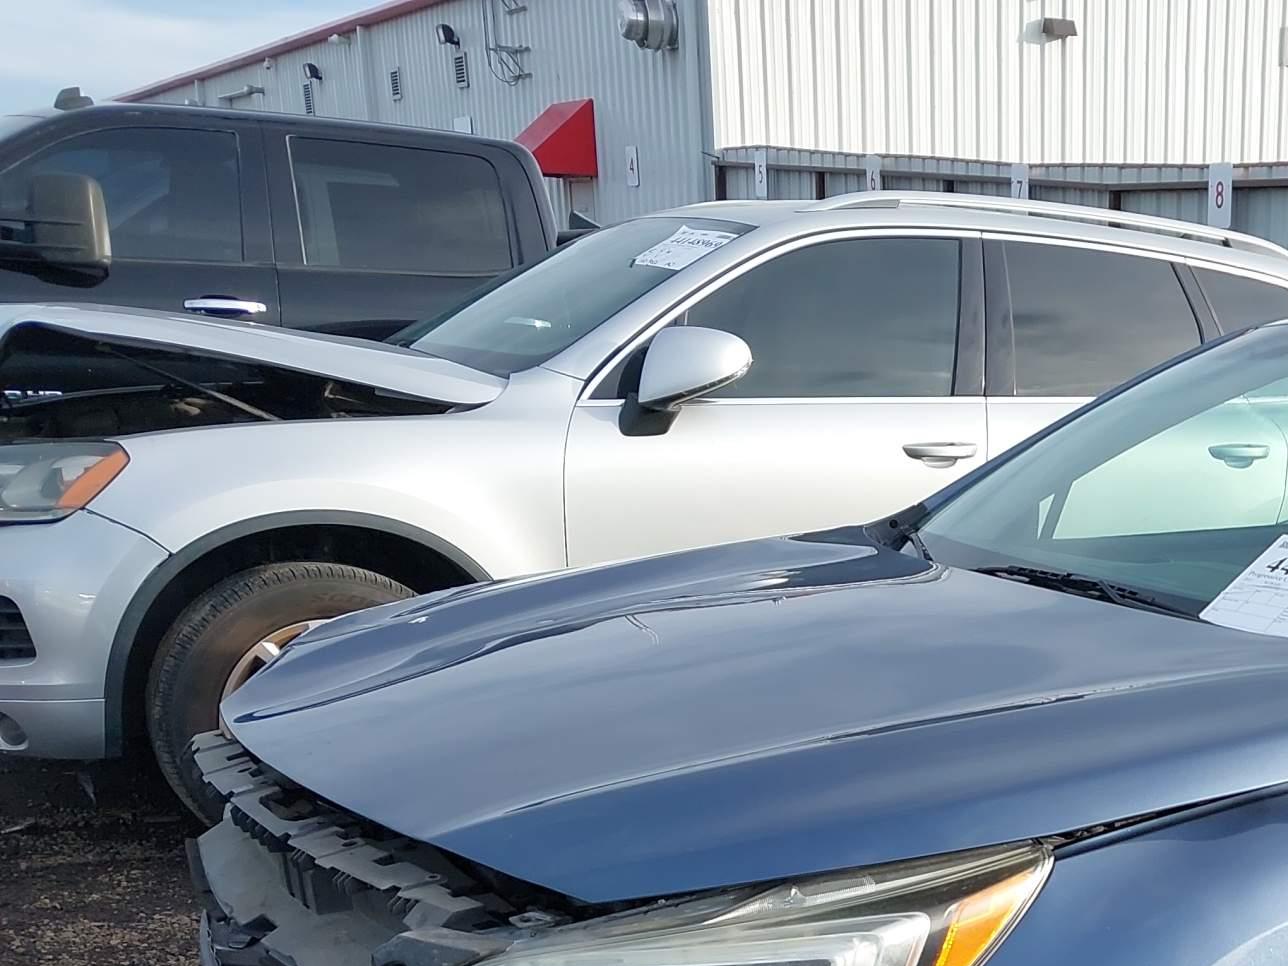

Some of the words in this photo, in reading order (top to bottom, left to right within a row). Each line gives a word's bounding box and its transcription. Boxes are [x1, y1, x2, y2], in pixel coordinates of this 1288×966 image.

[629, 157, 635, 175] 4
[758, 164, 764, 183] 5
[870, 170, 876, 191] 6
[1016, 180, 1023, 199] 7
[1215, 181, 1224, 208] 8
